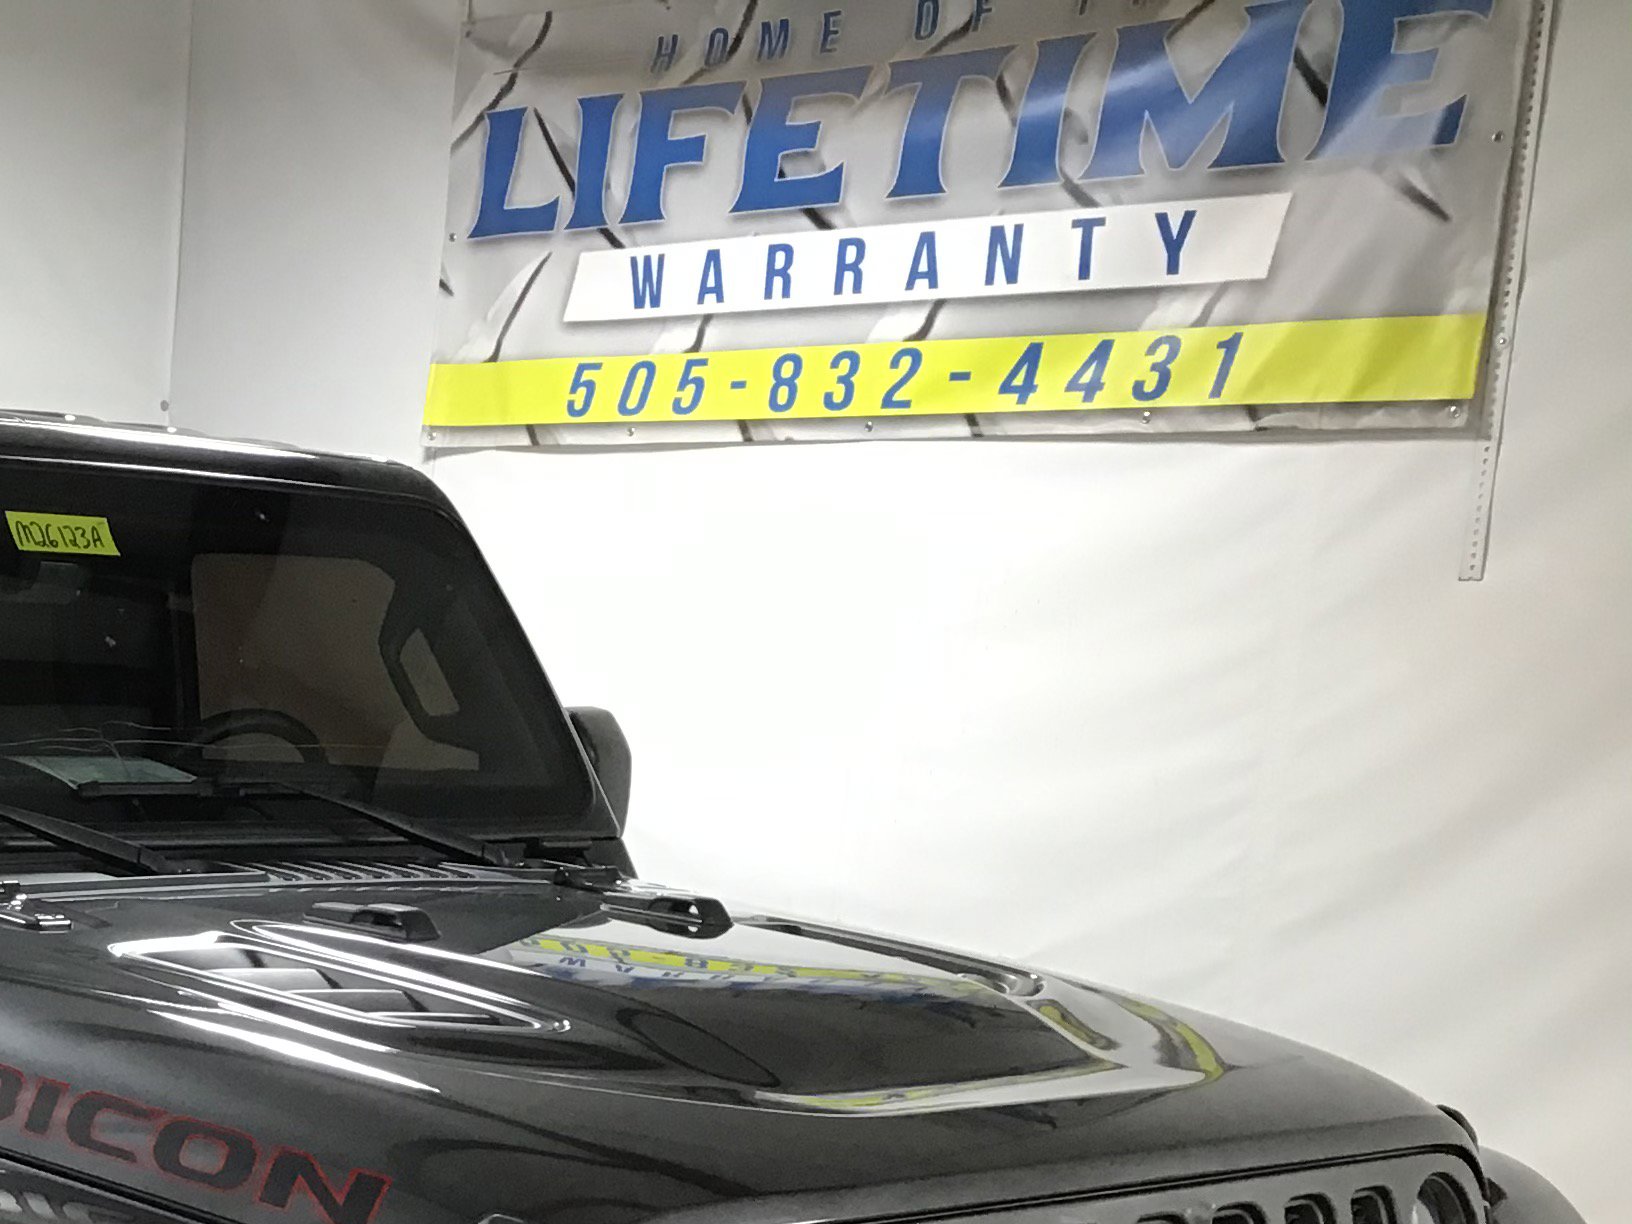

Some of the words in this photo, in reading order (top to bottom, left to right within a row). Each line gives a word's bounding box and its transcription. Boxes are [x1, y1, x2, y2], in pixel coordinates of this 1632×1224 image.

[651, 10, 842, 73] HOME
[467, 0, 1495, 239] LIFETIME
[630, 209, 1197, 310] WARRANTY
[565, 332, 1244, 418] 505-832-4431
